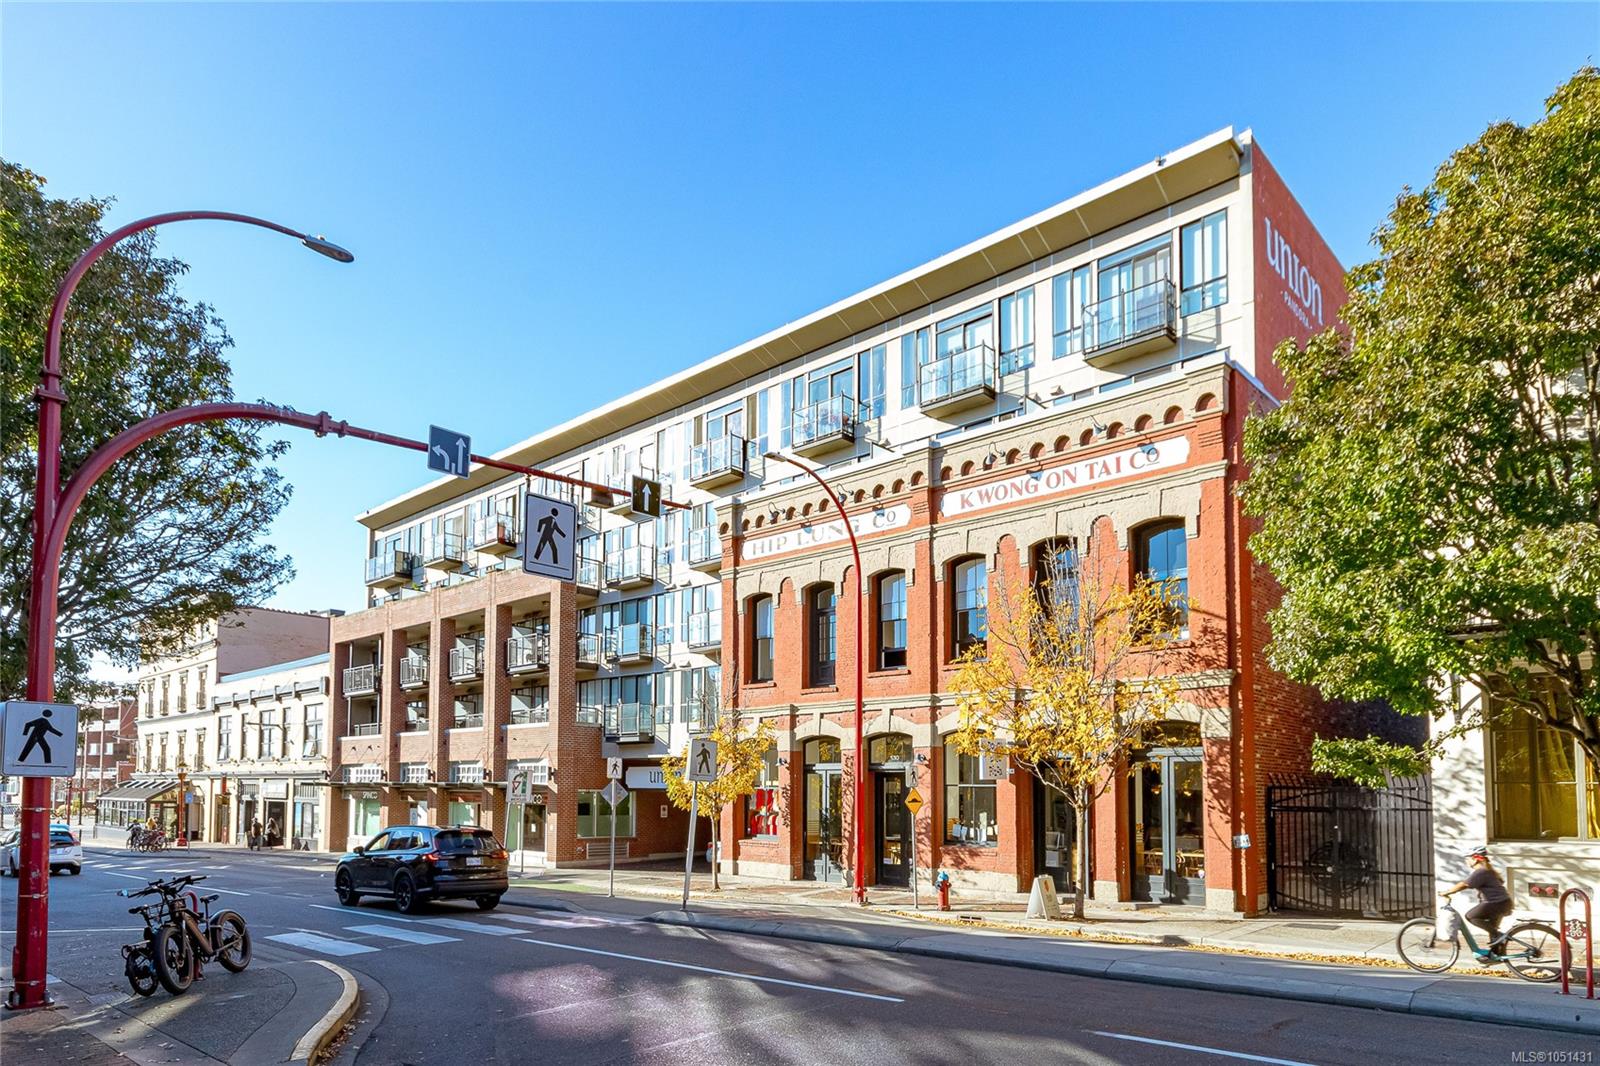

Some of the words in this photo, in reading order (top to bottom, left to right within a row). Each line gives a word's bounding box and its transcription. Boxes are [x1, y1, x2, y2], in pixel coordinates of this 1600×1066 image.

[1264, 216, 1323, 326] union
[960, 479, 1039, 510] KWONG
[1046, 467, 1077, 489] ON
[1085, 456, 1122, 480] TAI
[753, 535, 788, 556] HIP
